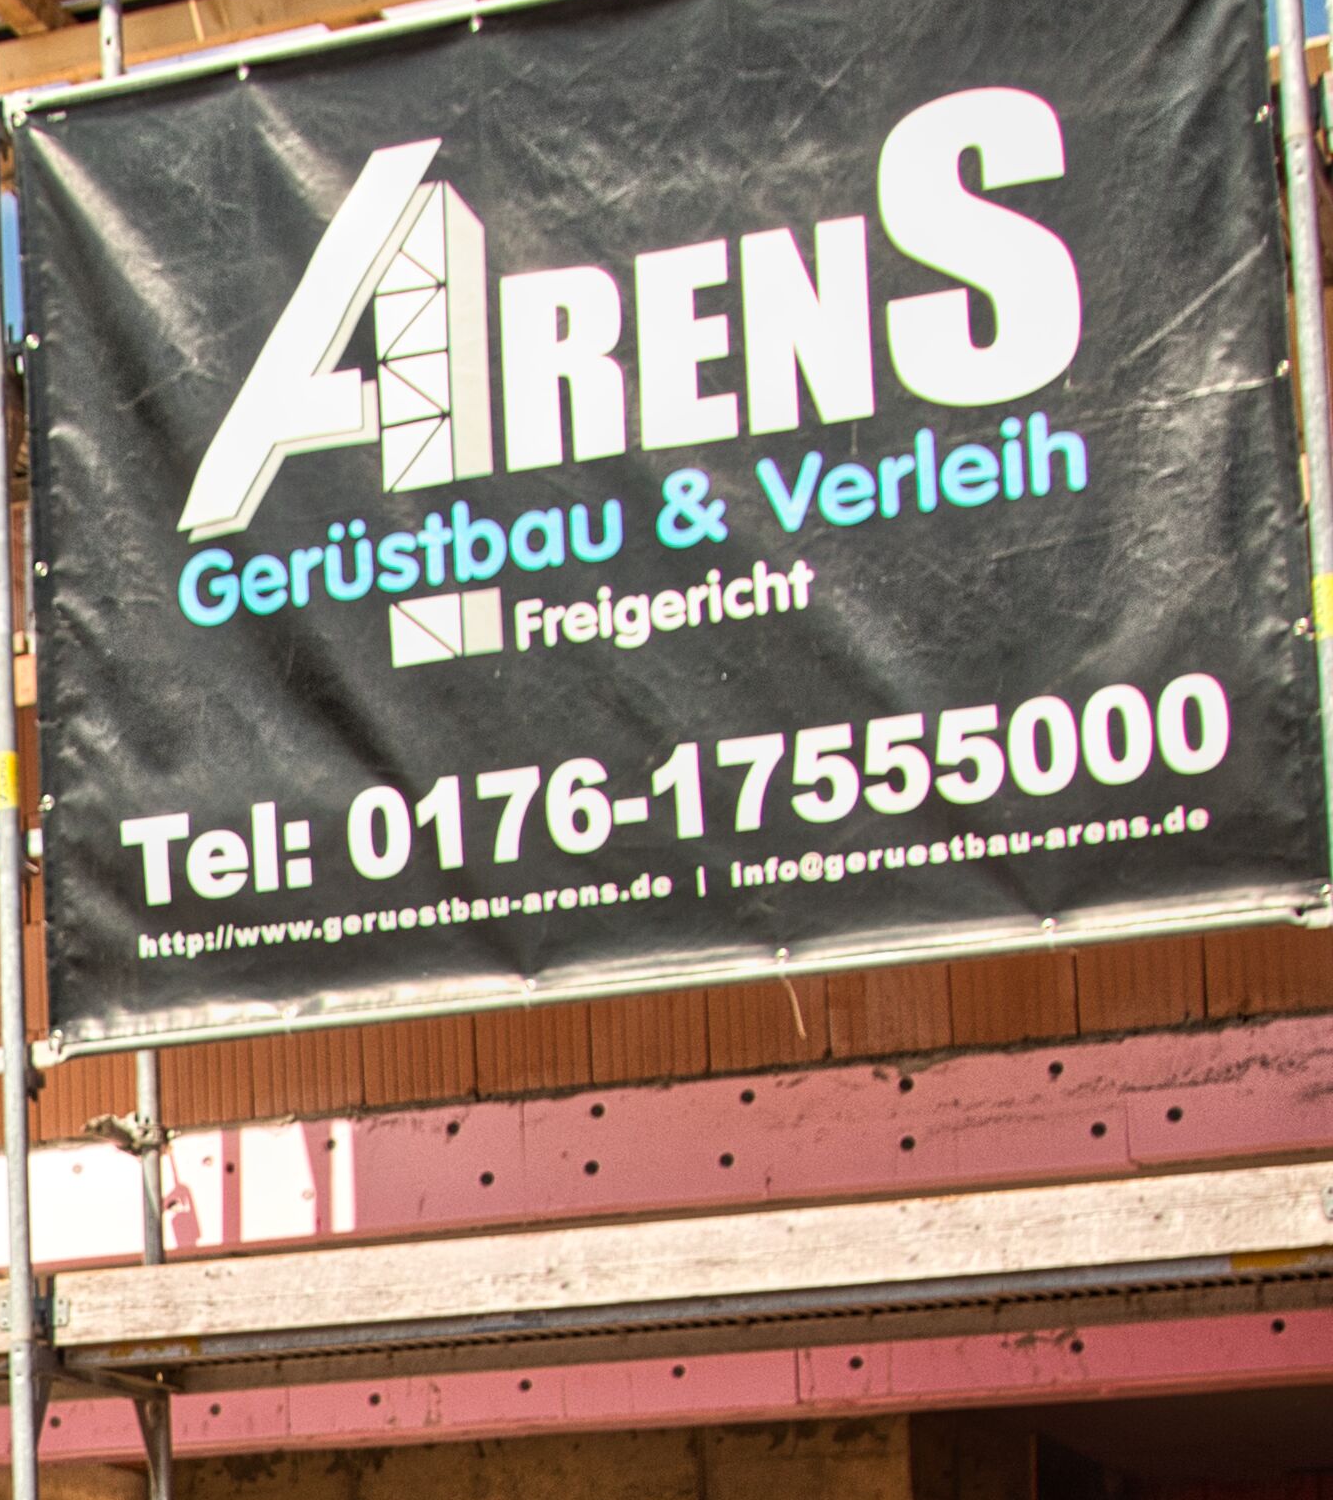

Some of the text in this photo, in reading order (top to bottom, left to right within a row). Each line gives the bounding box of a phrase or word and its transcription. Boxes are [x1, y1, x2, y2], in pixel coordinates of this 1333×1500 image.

[177, 411, 1089, 627] Gerüstbau & Verleih
[513, 559, 816, 652] Freigericht
[119, 672, 1231, 905] Tel: 0176-17555000
[137, 872, 673, 959] http://www.geruestbau-arens.de
[730, 805, 1210, 888] info@geruestbau-arens.de
